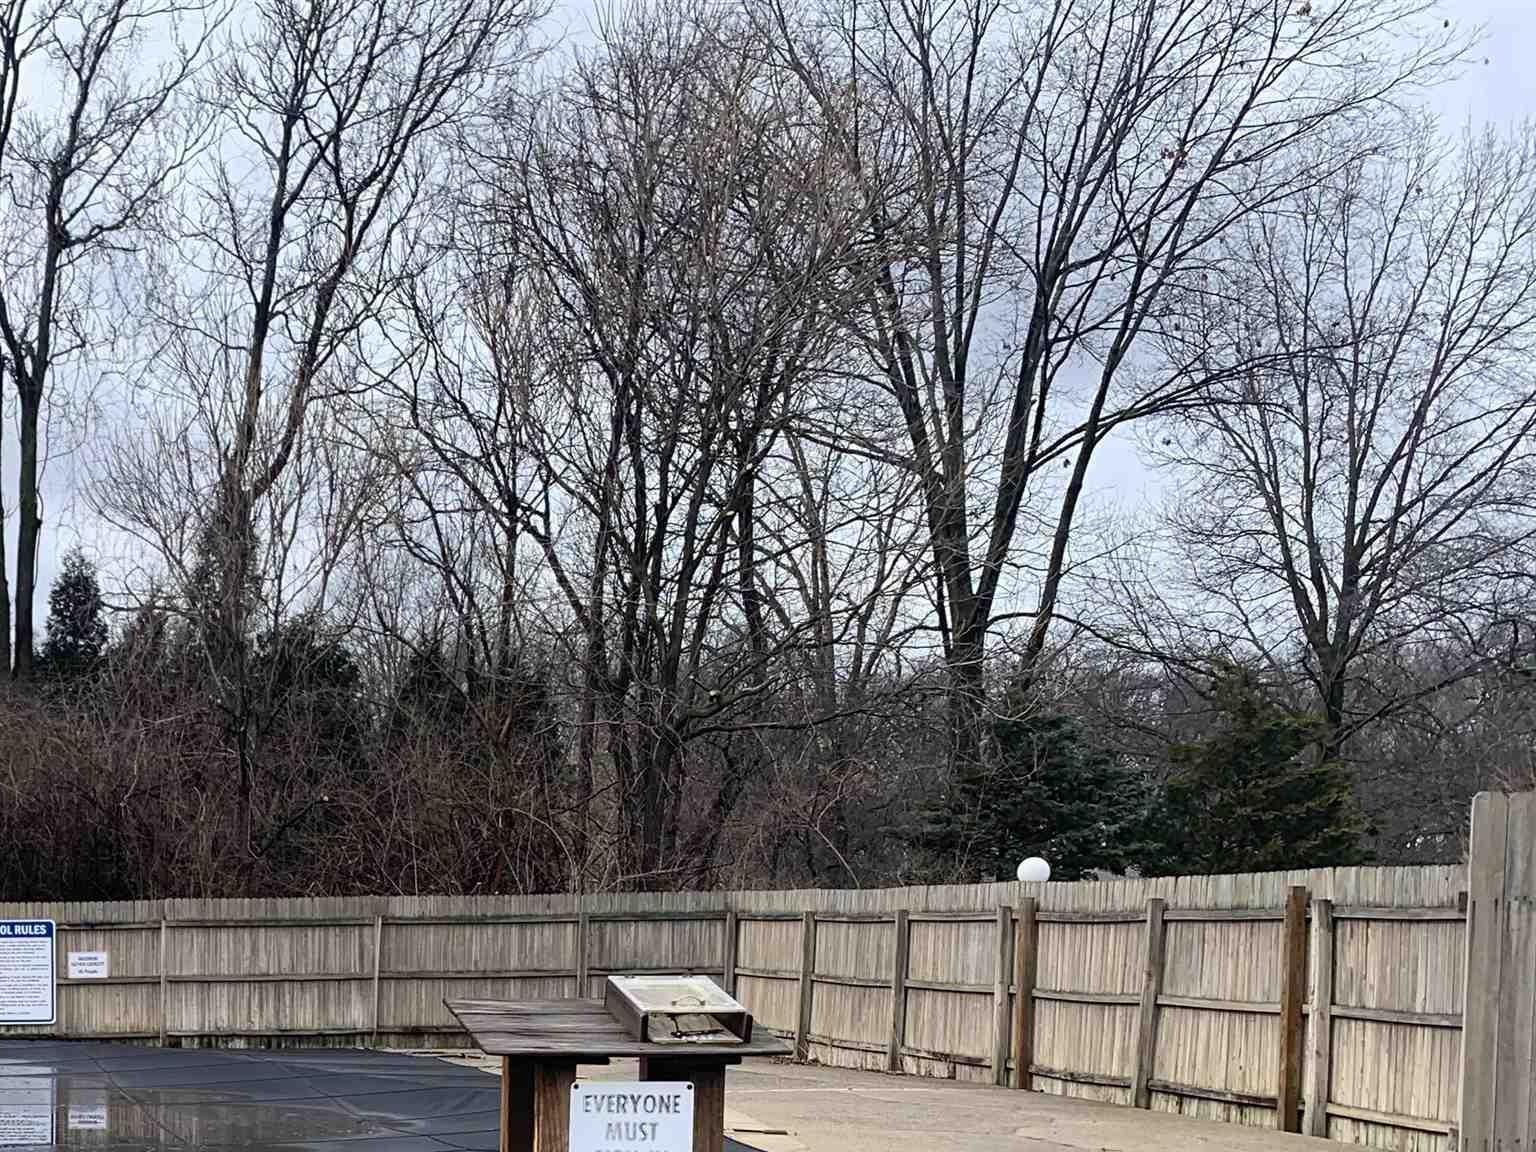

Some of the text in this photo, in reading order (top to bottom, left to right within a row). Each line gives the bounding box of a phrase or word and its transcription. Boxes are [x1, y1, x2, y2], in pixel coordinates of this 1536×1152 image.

[15, 925, 47, 935] RULES
[583, 1094, 681, 1114] EVERYONE
[605, 1122, 659, 1142] MUST
